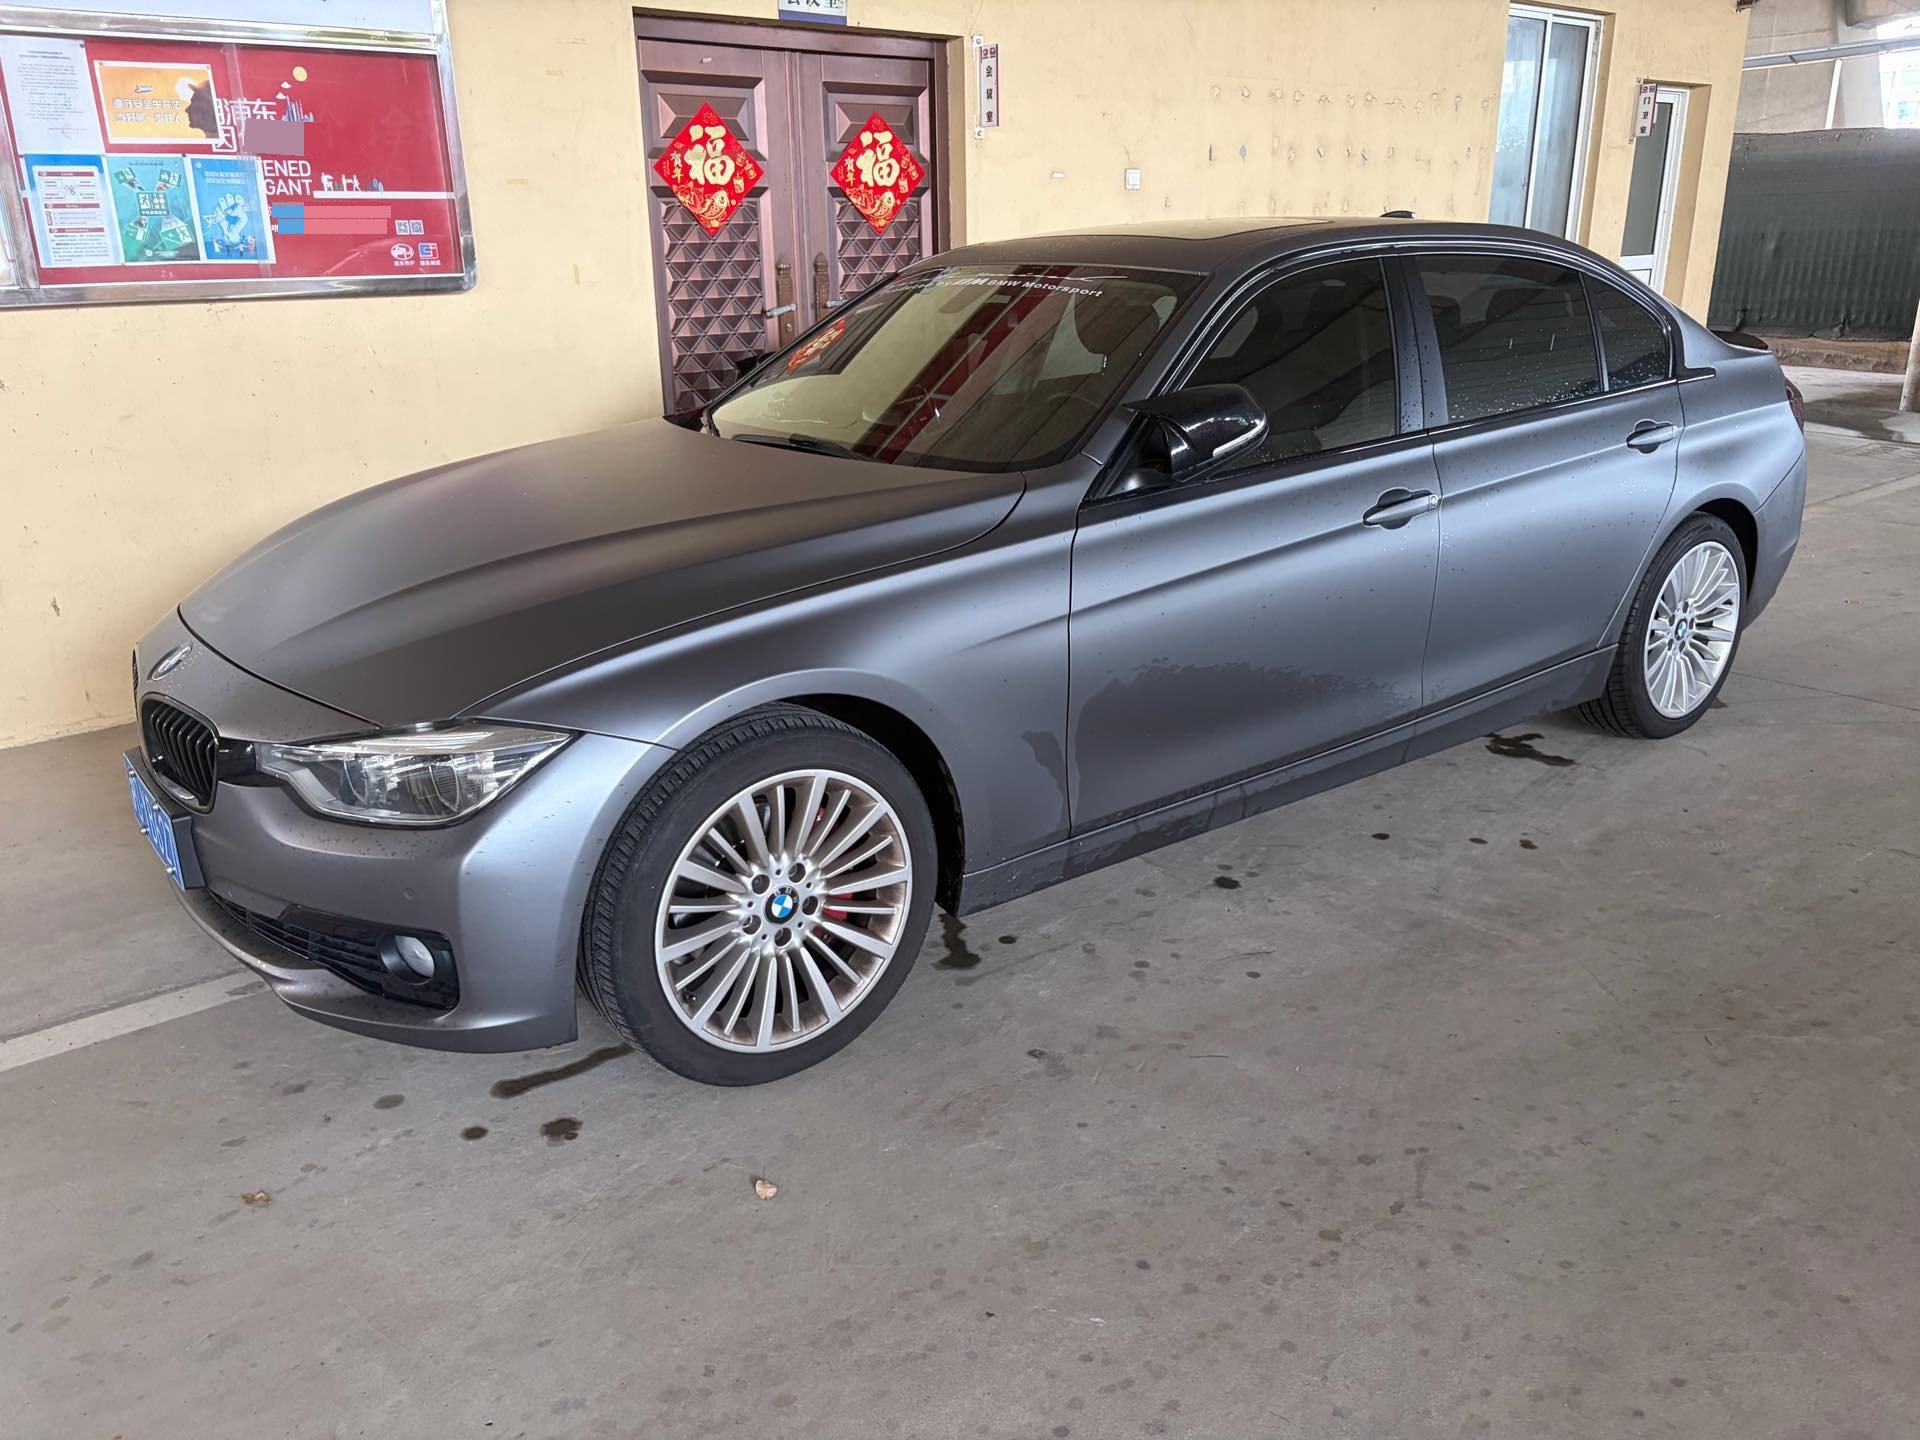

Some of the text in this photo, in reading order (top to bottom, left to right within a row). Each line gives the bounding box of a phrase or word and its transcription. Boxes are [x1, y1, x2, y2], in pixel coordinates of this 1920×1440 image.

[985, 64, 994, 123] 会议室
[262, 159, 312, 177] ENED
[683, 124, 736, 186] 福
[856, 130, 901, 187] 福
[1021, 281, 1103, 297] Motorsport
